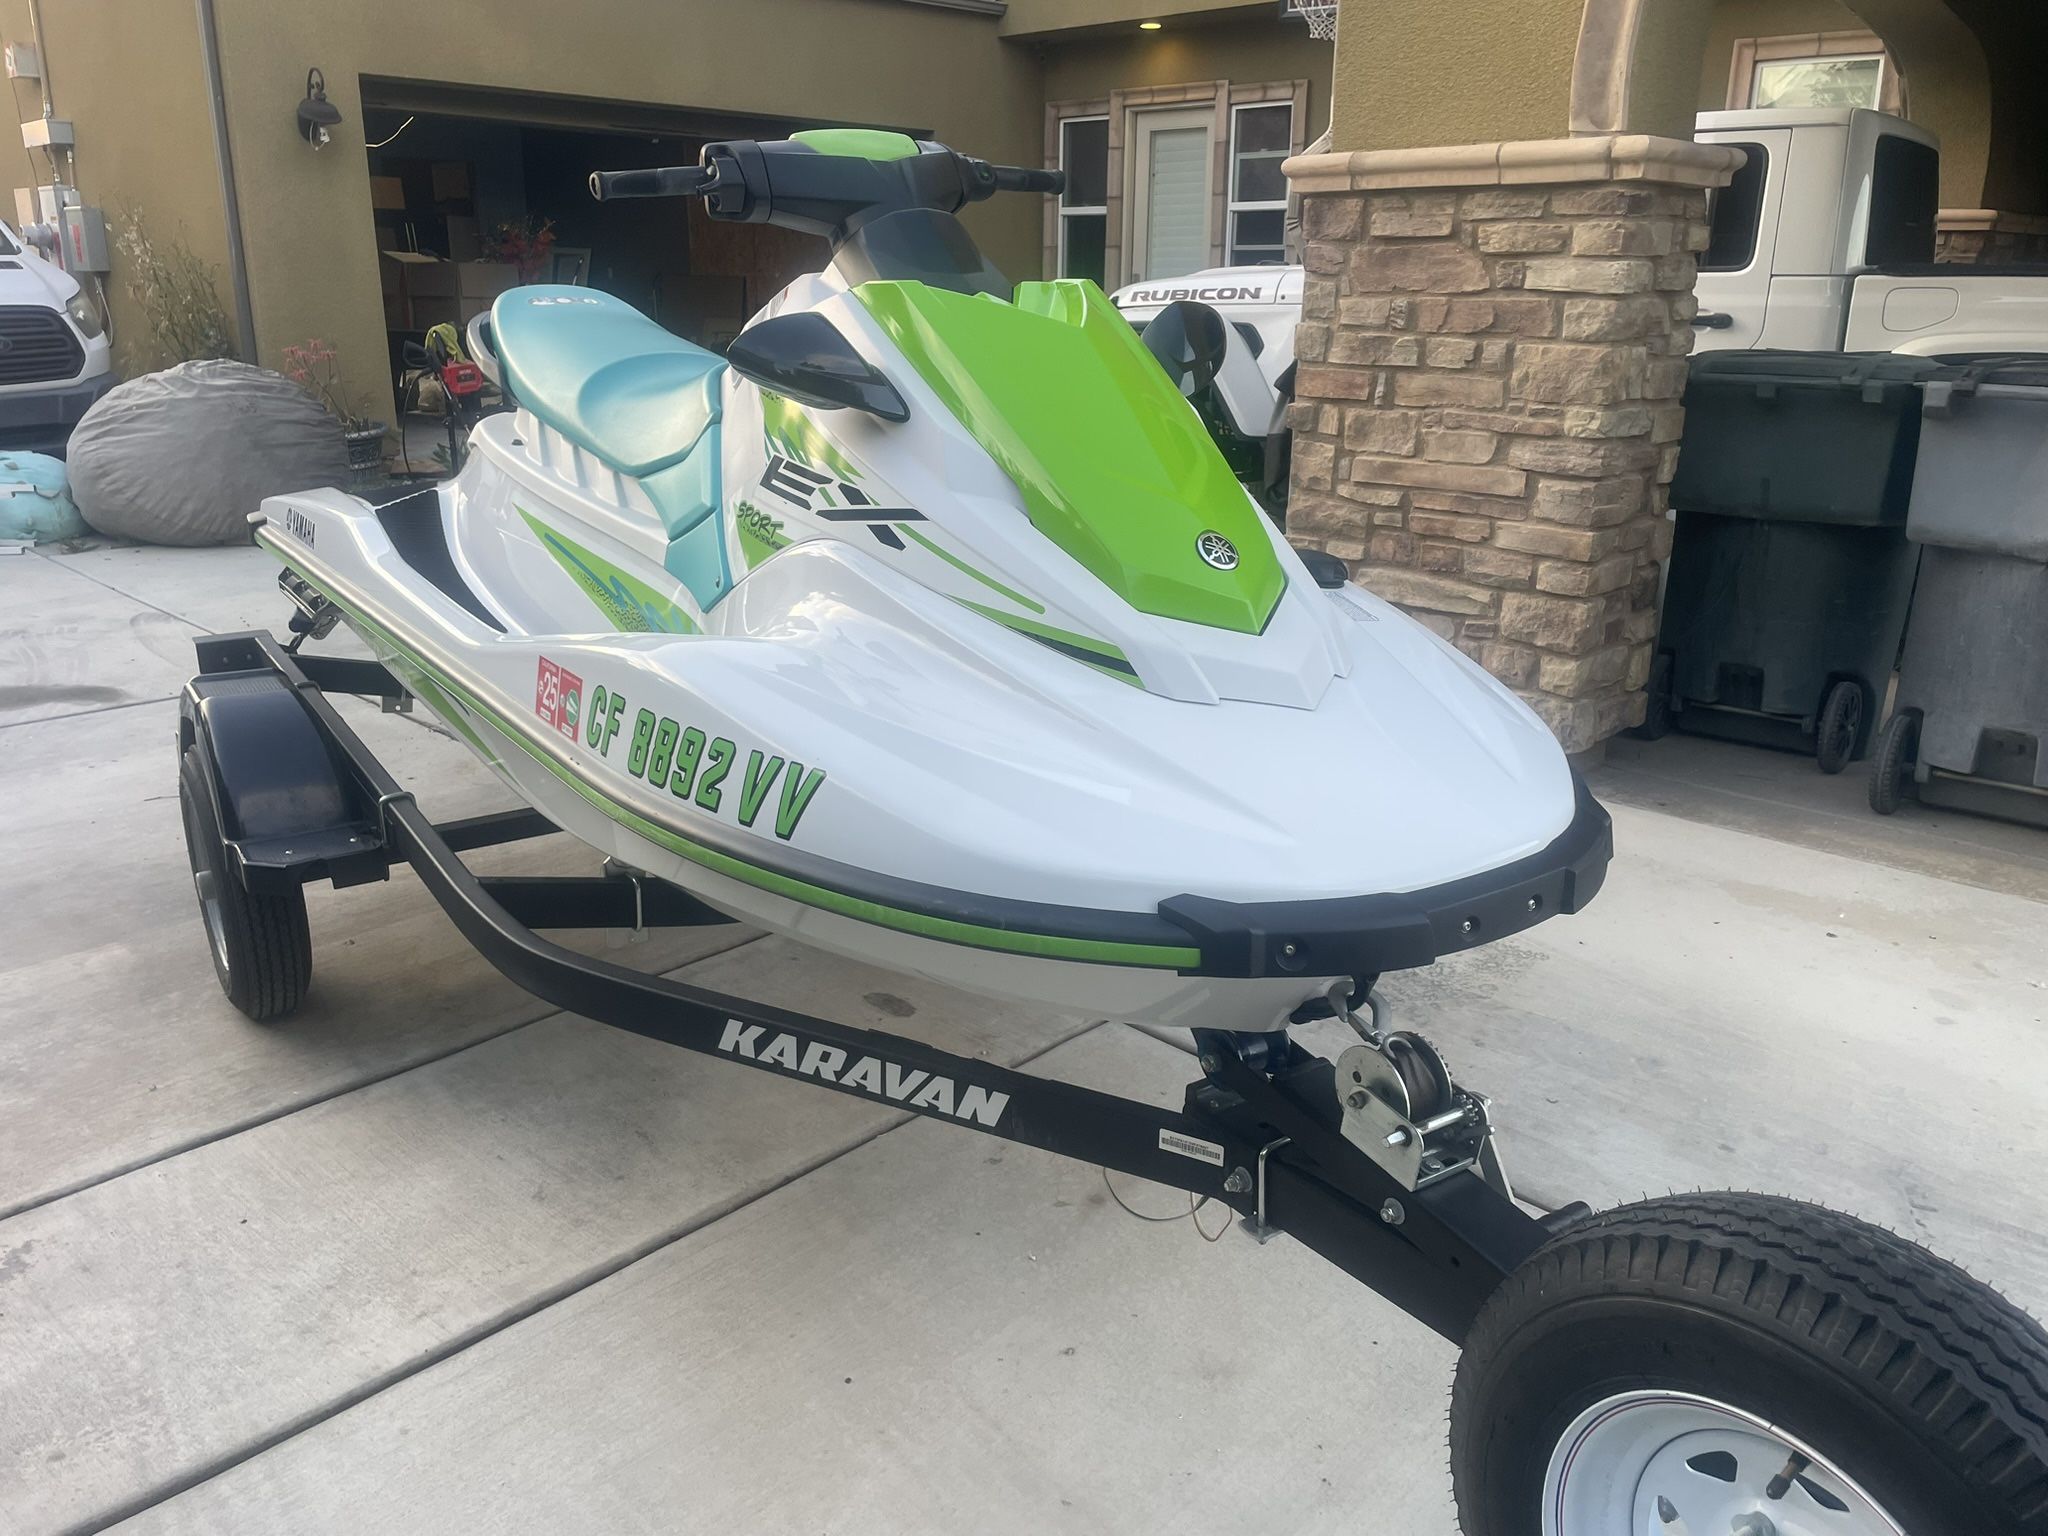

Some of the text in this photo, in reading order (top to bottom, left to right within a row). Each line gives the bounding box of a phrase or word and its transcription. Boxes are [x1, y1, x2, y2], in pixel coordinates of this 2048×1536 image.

[1130, 287, 1262, 303] RUBICON
[737, 500, 785, 540] SPORT
[759, 453, 930, 552] EX
[292, 509, 316, 550] YAMAHA
[542, 671, 559, 712] 25
[586, 684, 627, 758] CF
[627, 707, 737, 814] 8892
[717, 1017, 1011, 1128] KARAVAN
